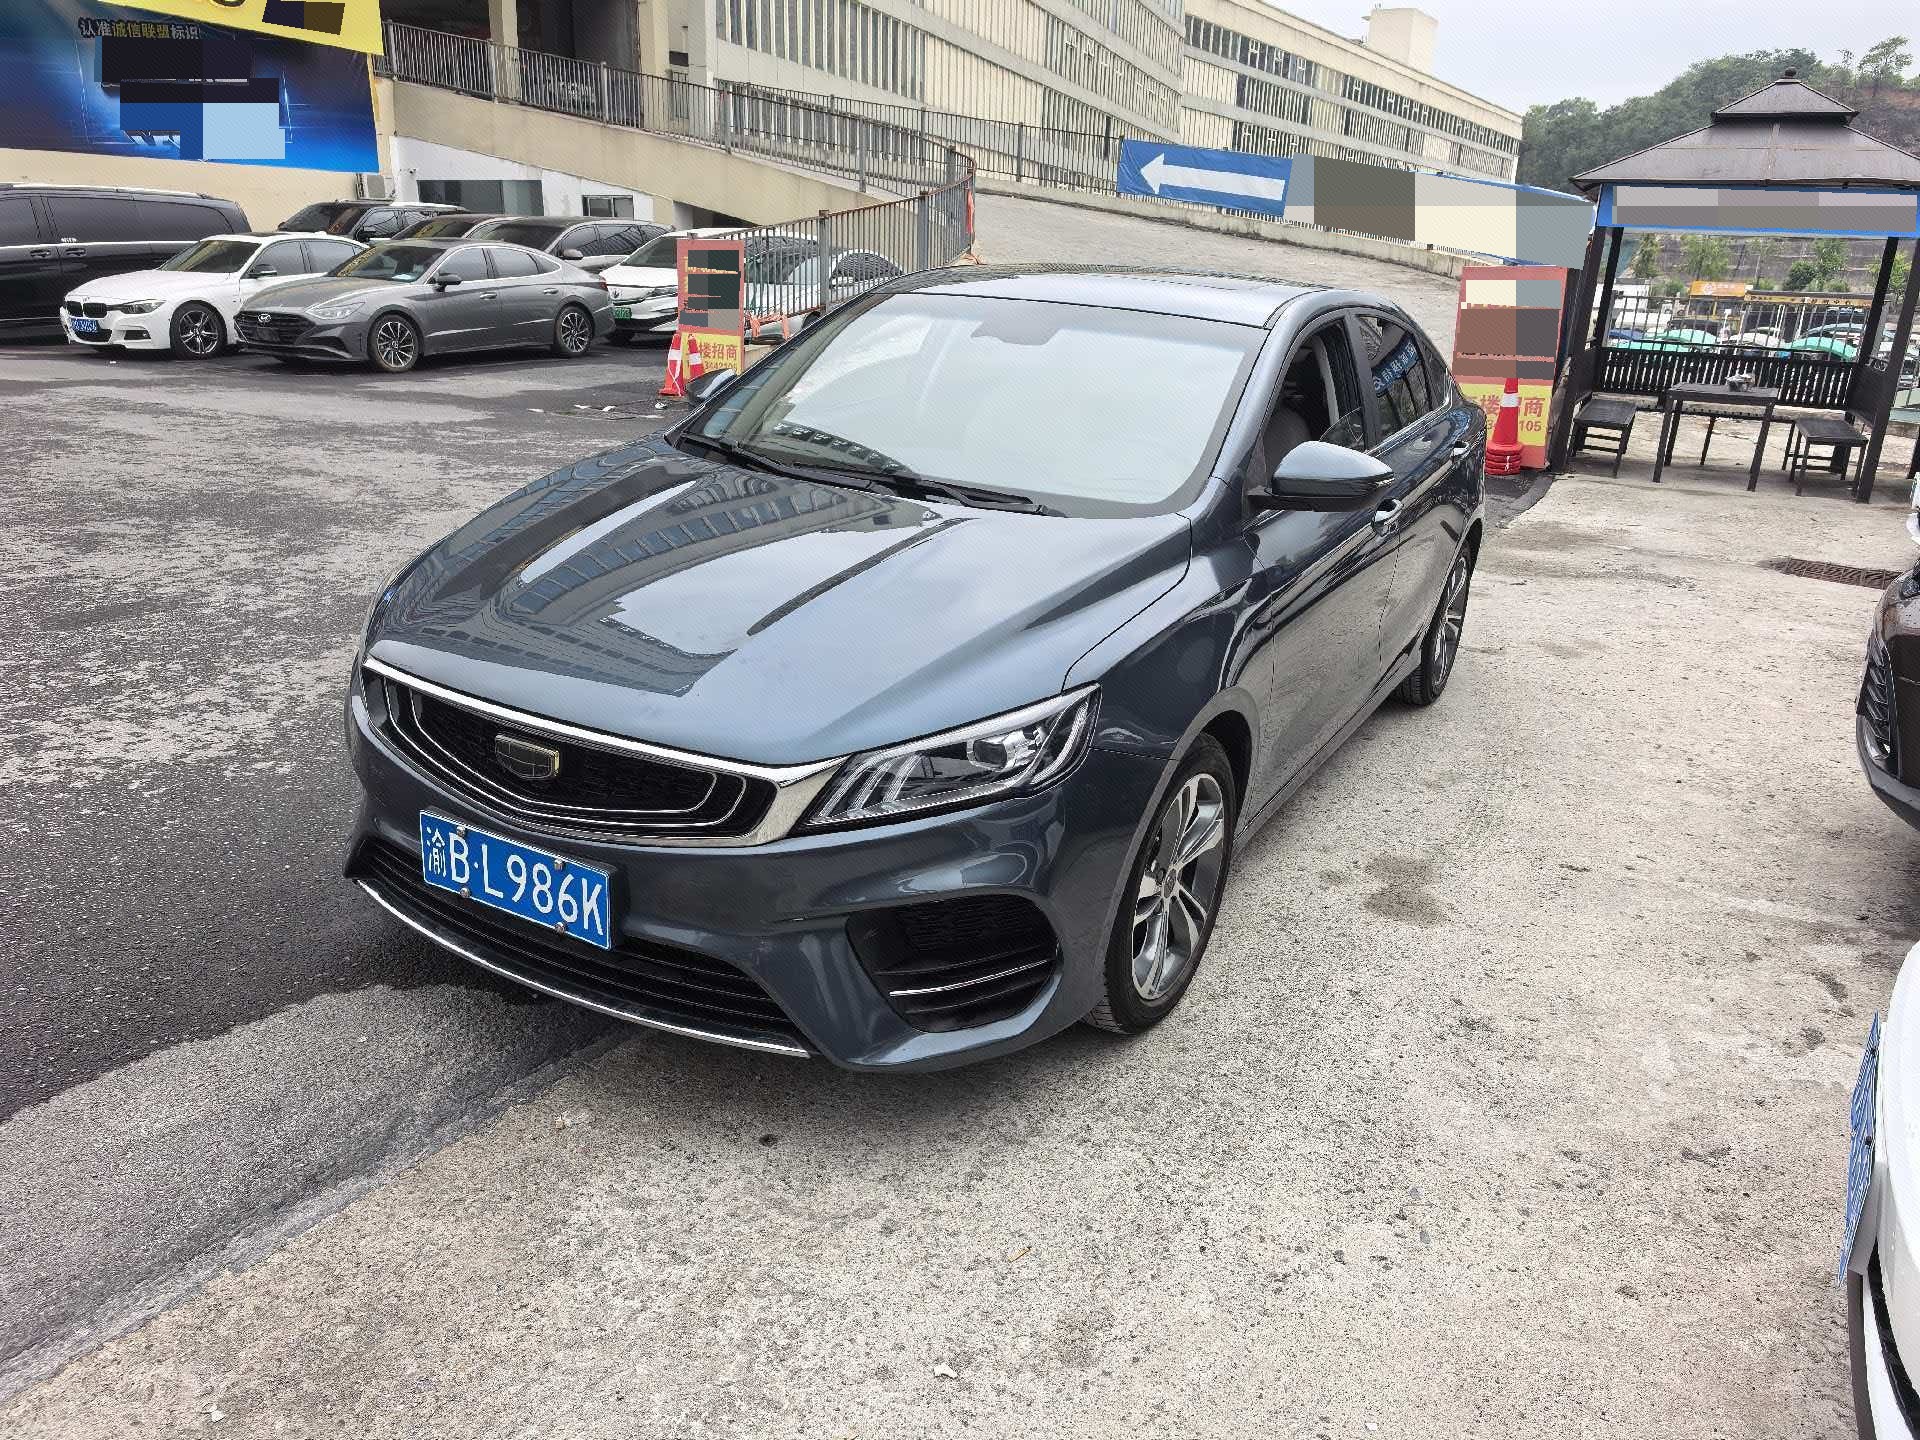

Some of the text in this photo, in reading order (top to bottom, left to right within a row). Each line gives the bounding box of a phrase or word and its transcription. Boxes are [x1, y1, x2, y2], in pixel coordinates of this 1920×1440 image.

[80, 19, 200, 39] 认准诚信联盟标识
[687, 341, 738, 361] 楼招商
